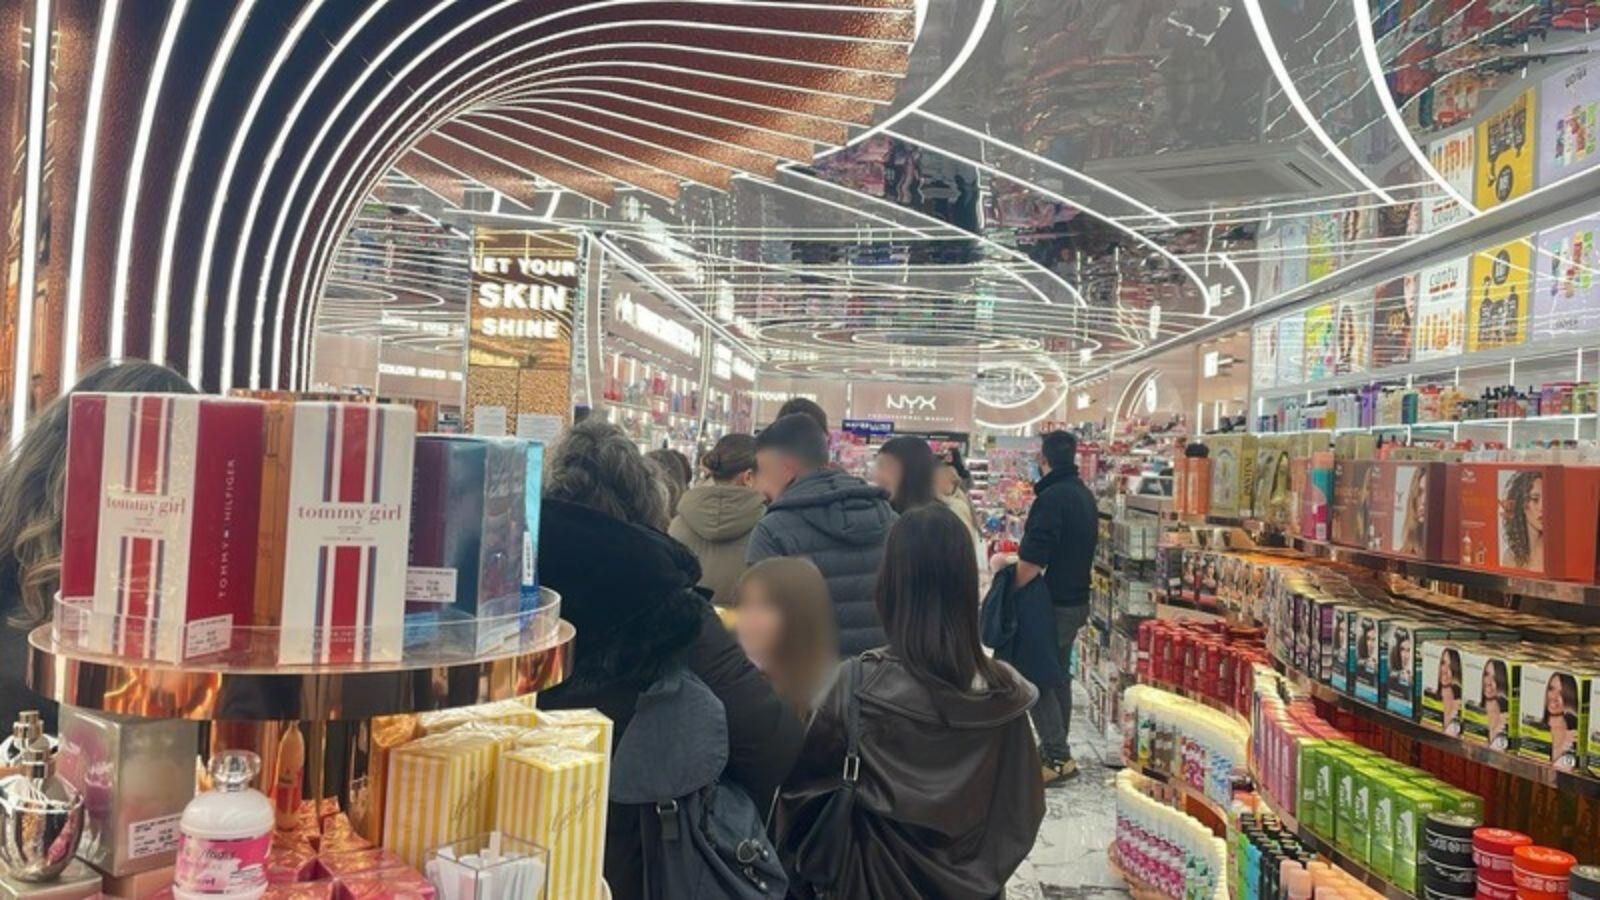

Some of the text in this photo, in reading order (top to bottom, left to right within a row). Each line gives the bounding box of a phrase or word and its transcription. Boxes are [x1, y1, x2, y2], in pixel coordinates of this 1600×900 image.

[471, 256, 577, 276] LET YOUR
[478, 281, 567, 311] SKIN
[481, 316, 560, 339] SHINE
[886, 393, 937, 414] NYX
[107, 497, 187, 518] tommy girl
[298, 503, 402, 525] tommy girl
[217, 459, 235, 599] TOMMY HILFIGER
